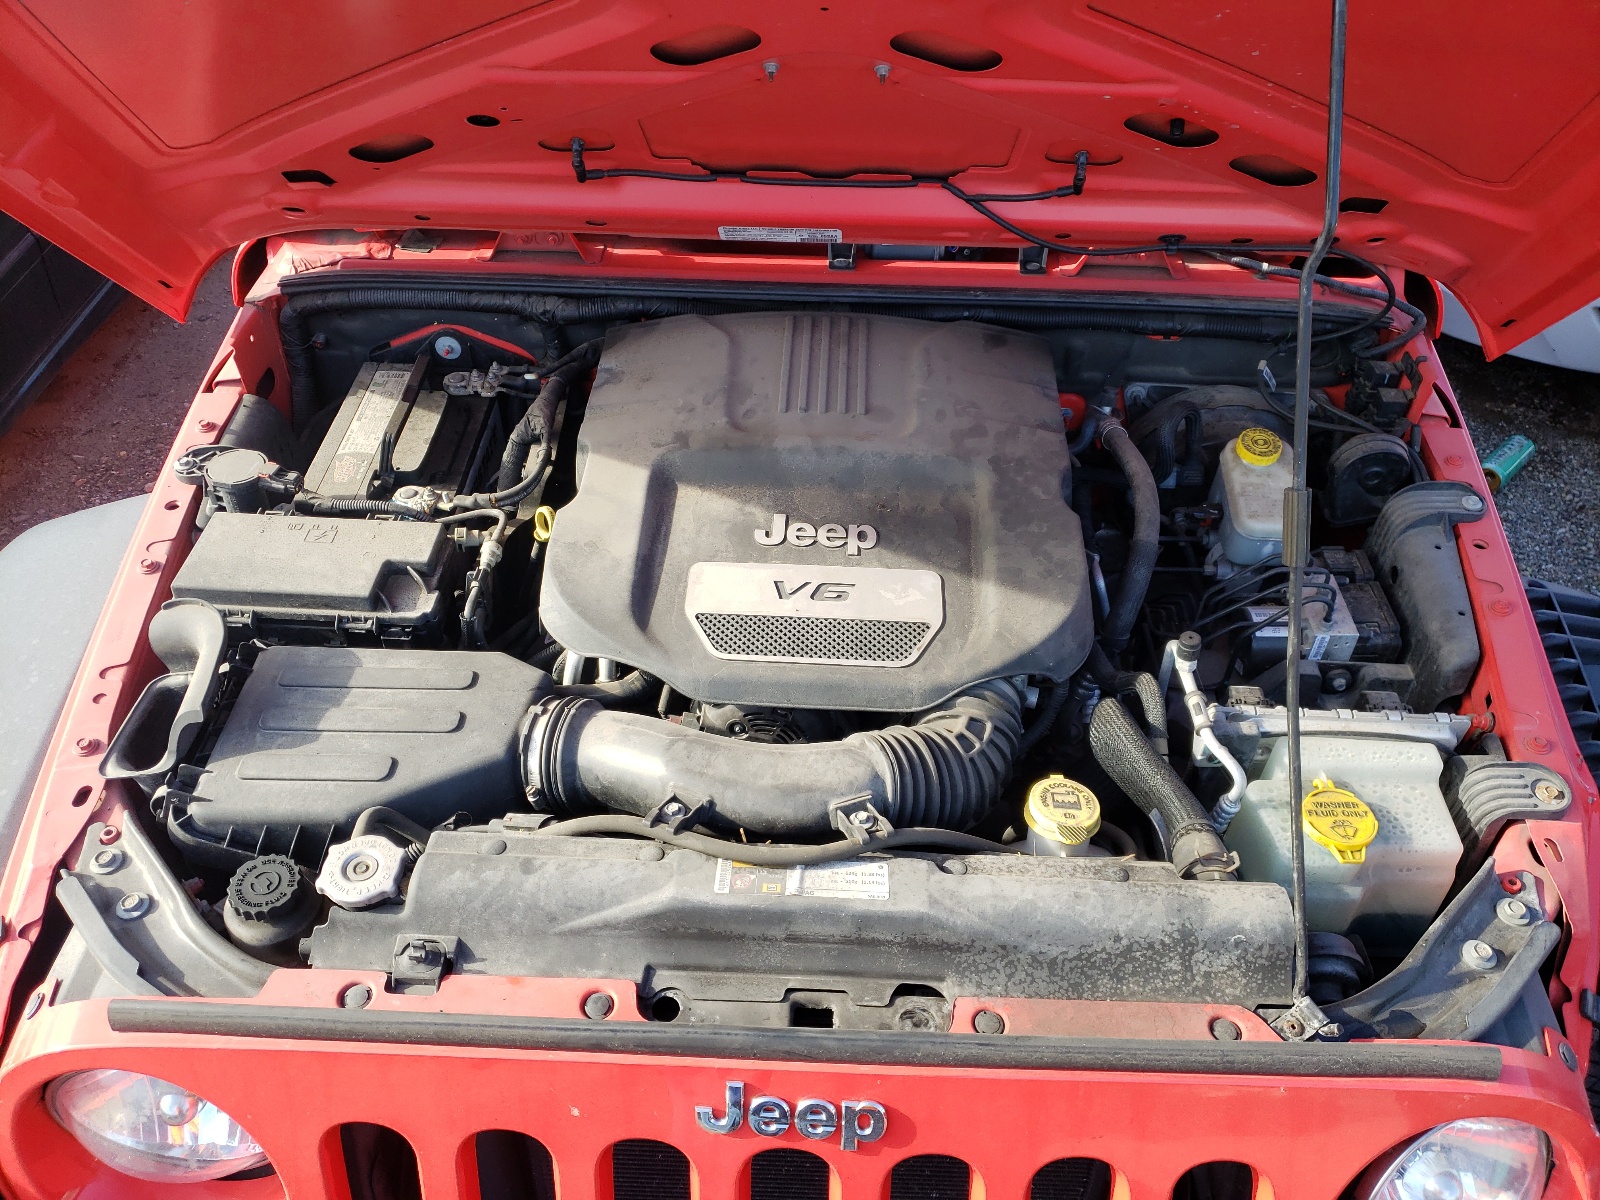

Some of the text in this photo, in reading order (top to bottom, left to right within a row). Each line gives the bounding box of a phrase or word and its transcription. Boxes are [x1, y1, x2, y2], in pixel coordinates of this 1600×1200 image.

[754, 514, 879, 556] Jeep
[773, 580, 856, 602] V6
[1048, 782, 1085, 794] COOLANT
[1082, 794, 1093, 811] ONLY
[1311, 801, 1360, 809] WASHER
[1306, 809, 1369, 818] FLUID ONLY
[694, 1080, 888, 1151] Jeep
